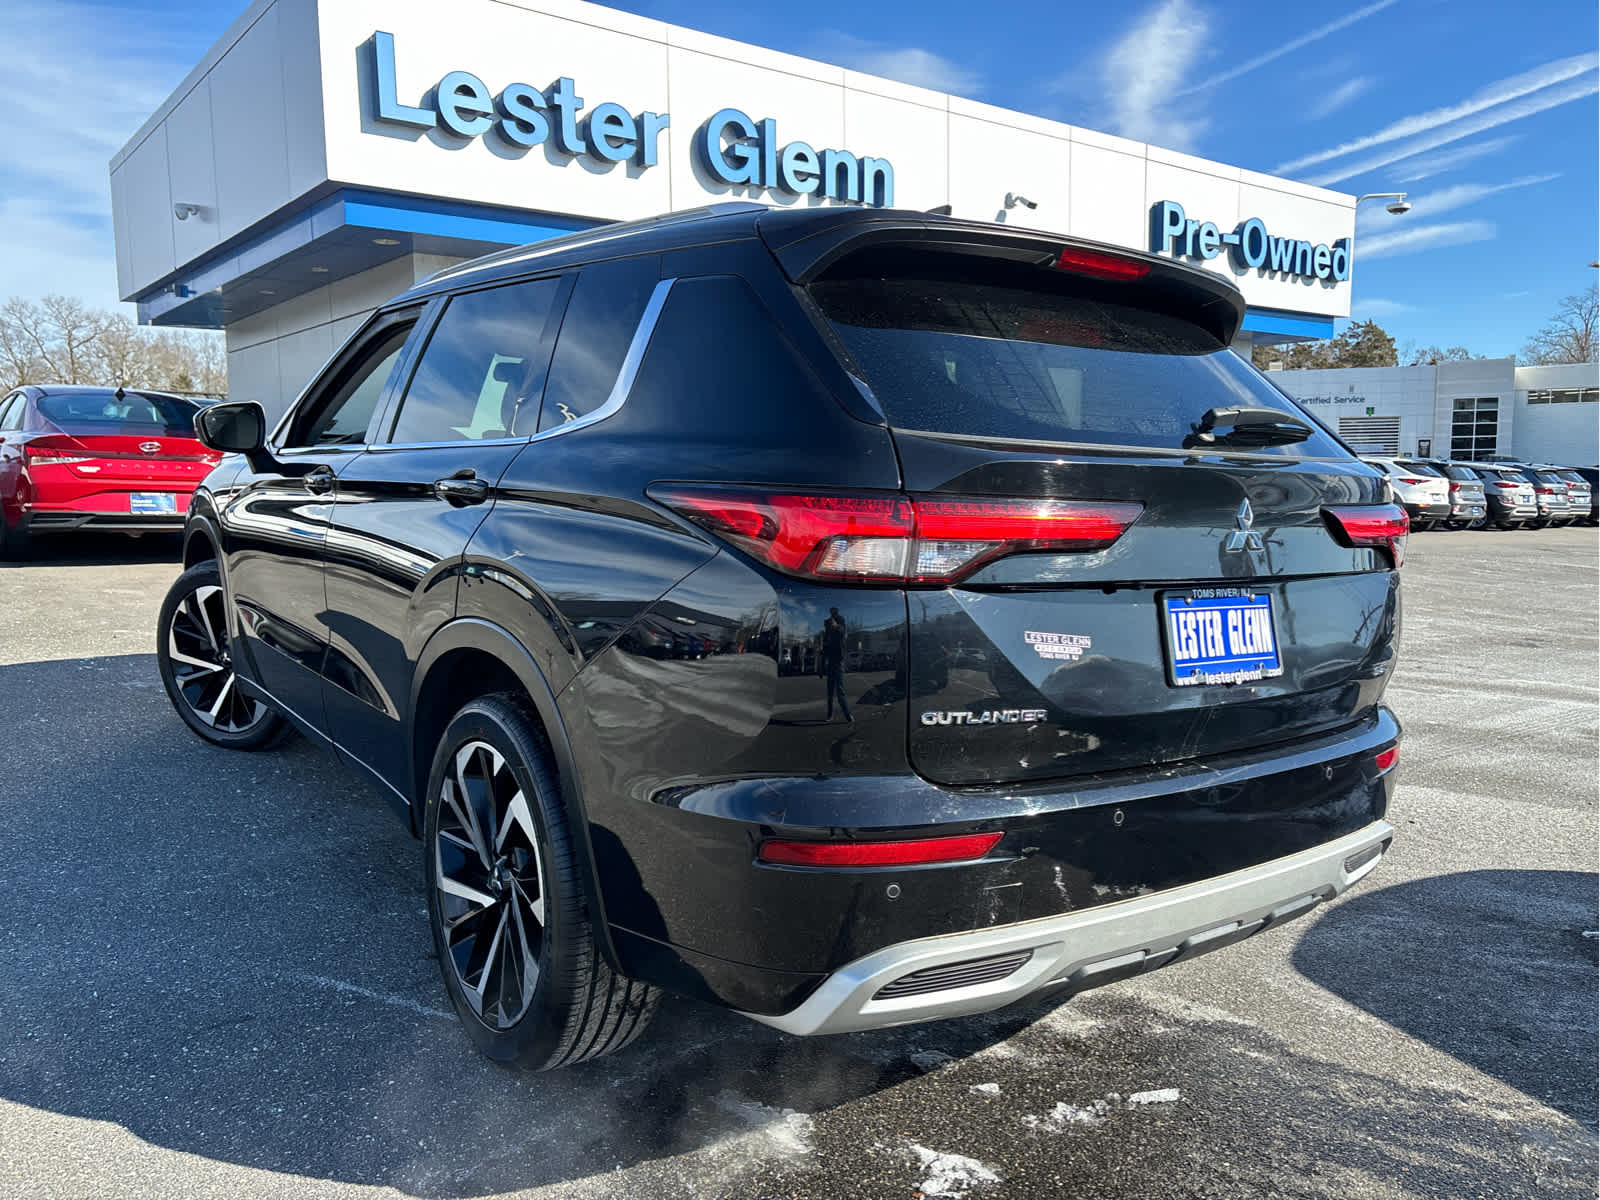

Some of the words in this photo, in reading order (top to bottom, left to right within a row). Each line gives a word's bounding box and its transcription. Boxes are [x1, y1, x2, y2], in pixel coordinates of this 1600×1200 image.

[366, 30, 671, 168] Lester
[702, 107, 895, 208] Glenn
[1154, 199, 1352, 283] Pre-Owned
[1296, 393, 1331, 405] Certified
[1334, 394, 1365, 404] Service
[1191, 588, 1215, 599] TOMS
[1024, 632, 1060, 644] LESTER
[1061, 634, 1090, 647] GLENN
[1171, 609, 1226, 660] LESTER
[1227, 608, 1274, 656] GLENN
[1205, 669, 1262, 685] lesterglenn
[921, 709, 1048, 726] OUTLANDER
